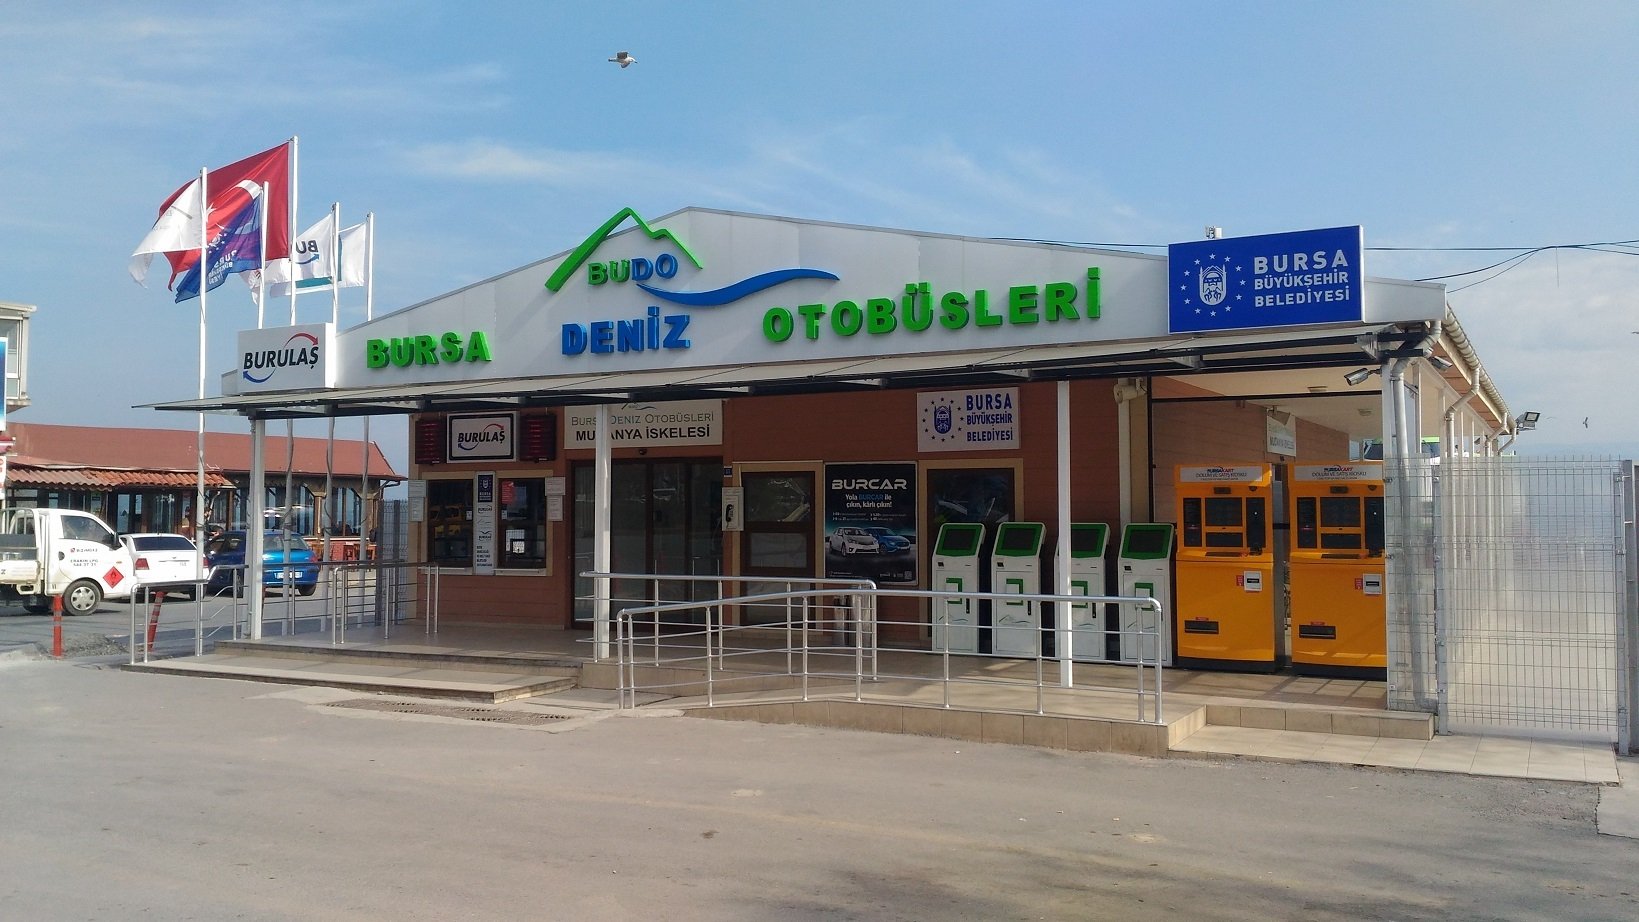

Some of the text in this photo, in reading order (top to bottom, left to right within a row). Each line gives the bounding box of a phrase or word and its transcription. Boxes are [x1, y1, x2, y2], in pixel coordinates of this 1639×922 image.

[587, 253, 679, 285] BUDO
[1254, 249, 1348, 275] BURSA
[1254, 268, 1349, 290] BÜYÜKŞEHİR
[1255, 285, 1350, 307] BELEDİYESİ
[366, 266, 1101, 369] BURSA DENİZ OTOBÜSLERİ
[243, 346, 319, 370] BURULAŞ
[966, 393, 1013, 411] BURSA
[966, 411, 1013, 426] BÜYÜKŞEHİR
[457, 430, 506, 444] BURULAŞ
[646, 424, 710, 439] İSKELESİ
[967, 427, 1013, 442] BELEDİYESİ
[832, 479, 908, 490] BURCAR
[845, 493, 858, 501] Yola
